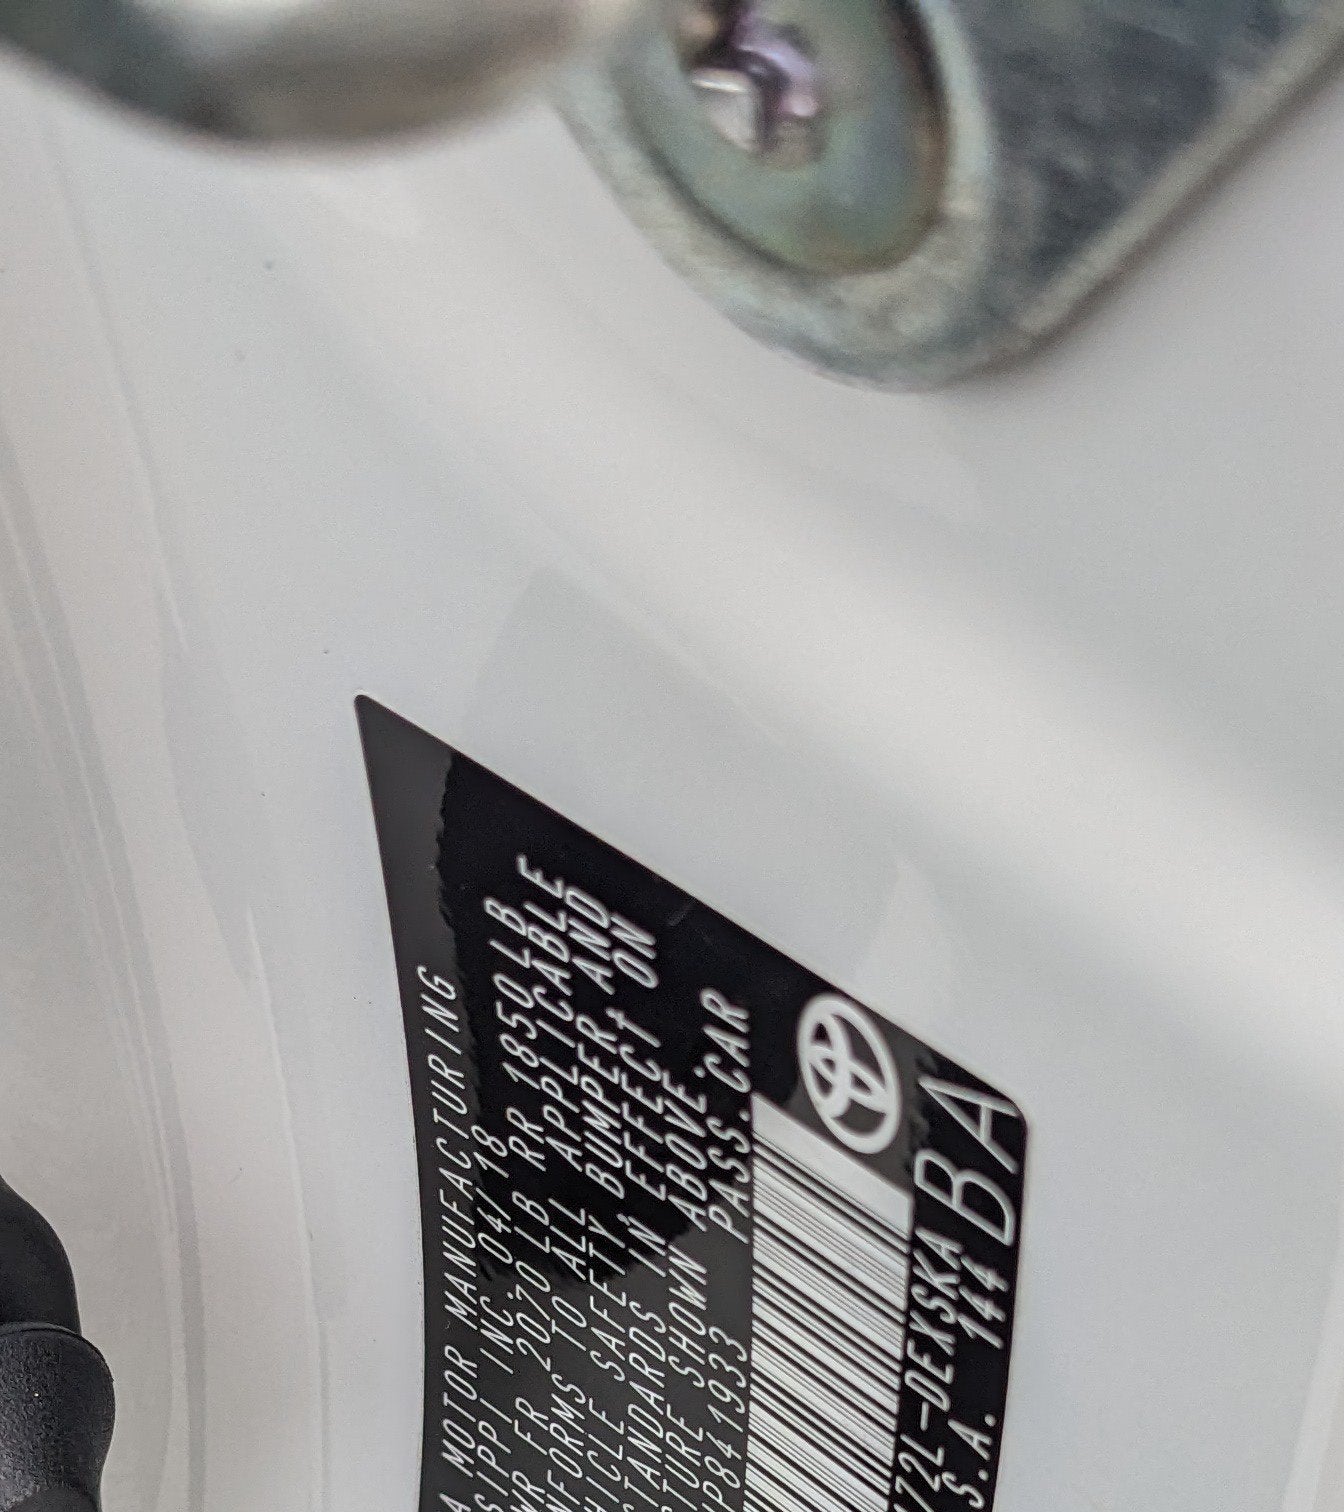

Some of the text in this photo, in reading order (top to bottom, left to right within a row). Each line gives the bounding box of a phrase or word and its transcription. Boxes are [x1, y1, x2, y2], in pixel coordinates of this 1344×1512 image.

[607, 911, 659, 990] ON
[516, 854, 583, 1171] APPLICABLE
[418, 966, 478, 1330] MANUFACTURING
[506, 1106, 547, 1171] RR
[615, 1010, 667, 1202] EFFECT
[913, 1074, 1020, 1247] BA
[471, 1125, 514, 1264] 04/18
[548, 1198, 586, 1281] ALL
[627, 1216, 666, 1278] IN
[551, 1296, 587, 1351] TO
[668, 1243, 708, 1388] SHOWN
[955, 1253, 1008, 1350] 144
[442, 1346, 477, 1478] MOTOR
[514, 1397, 549, 1455] FR
